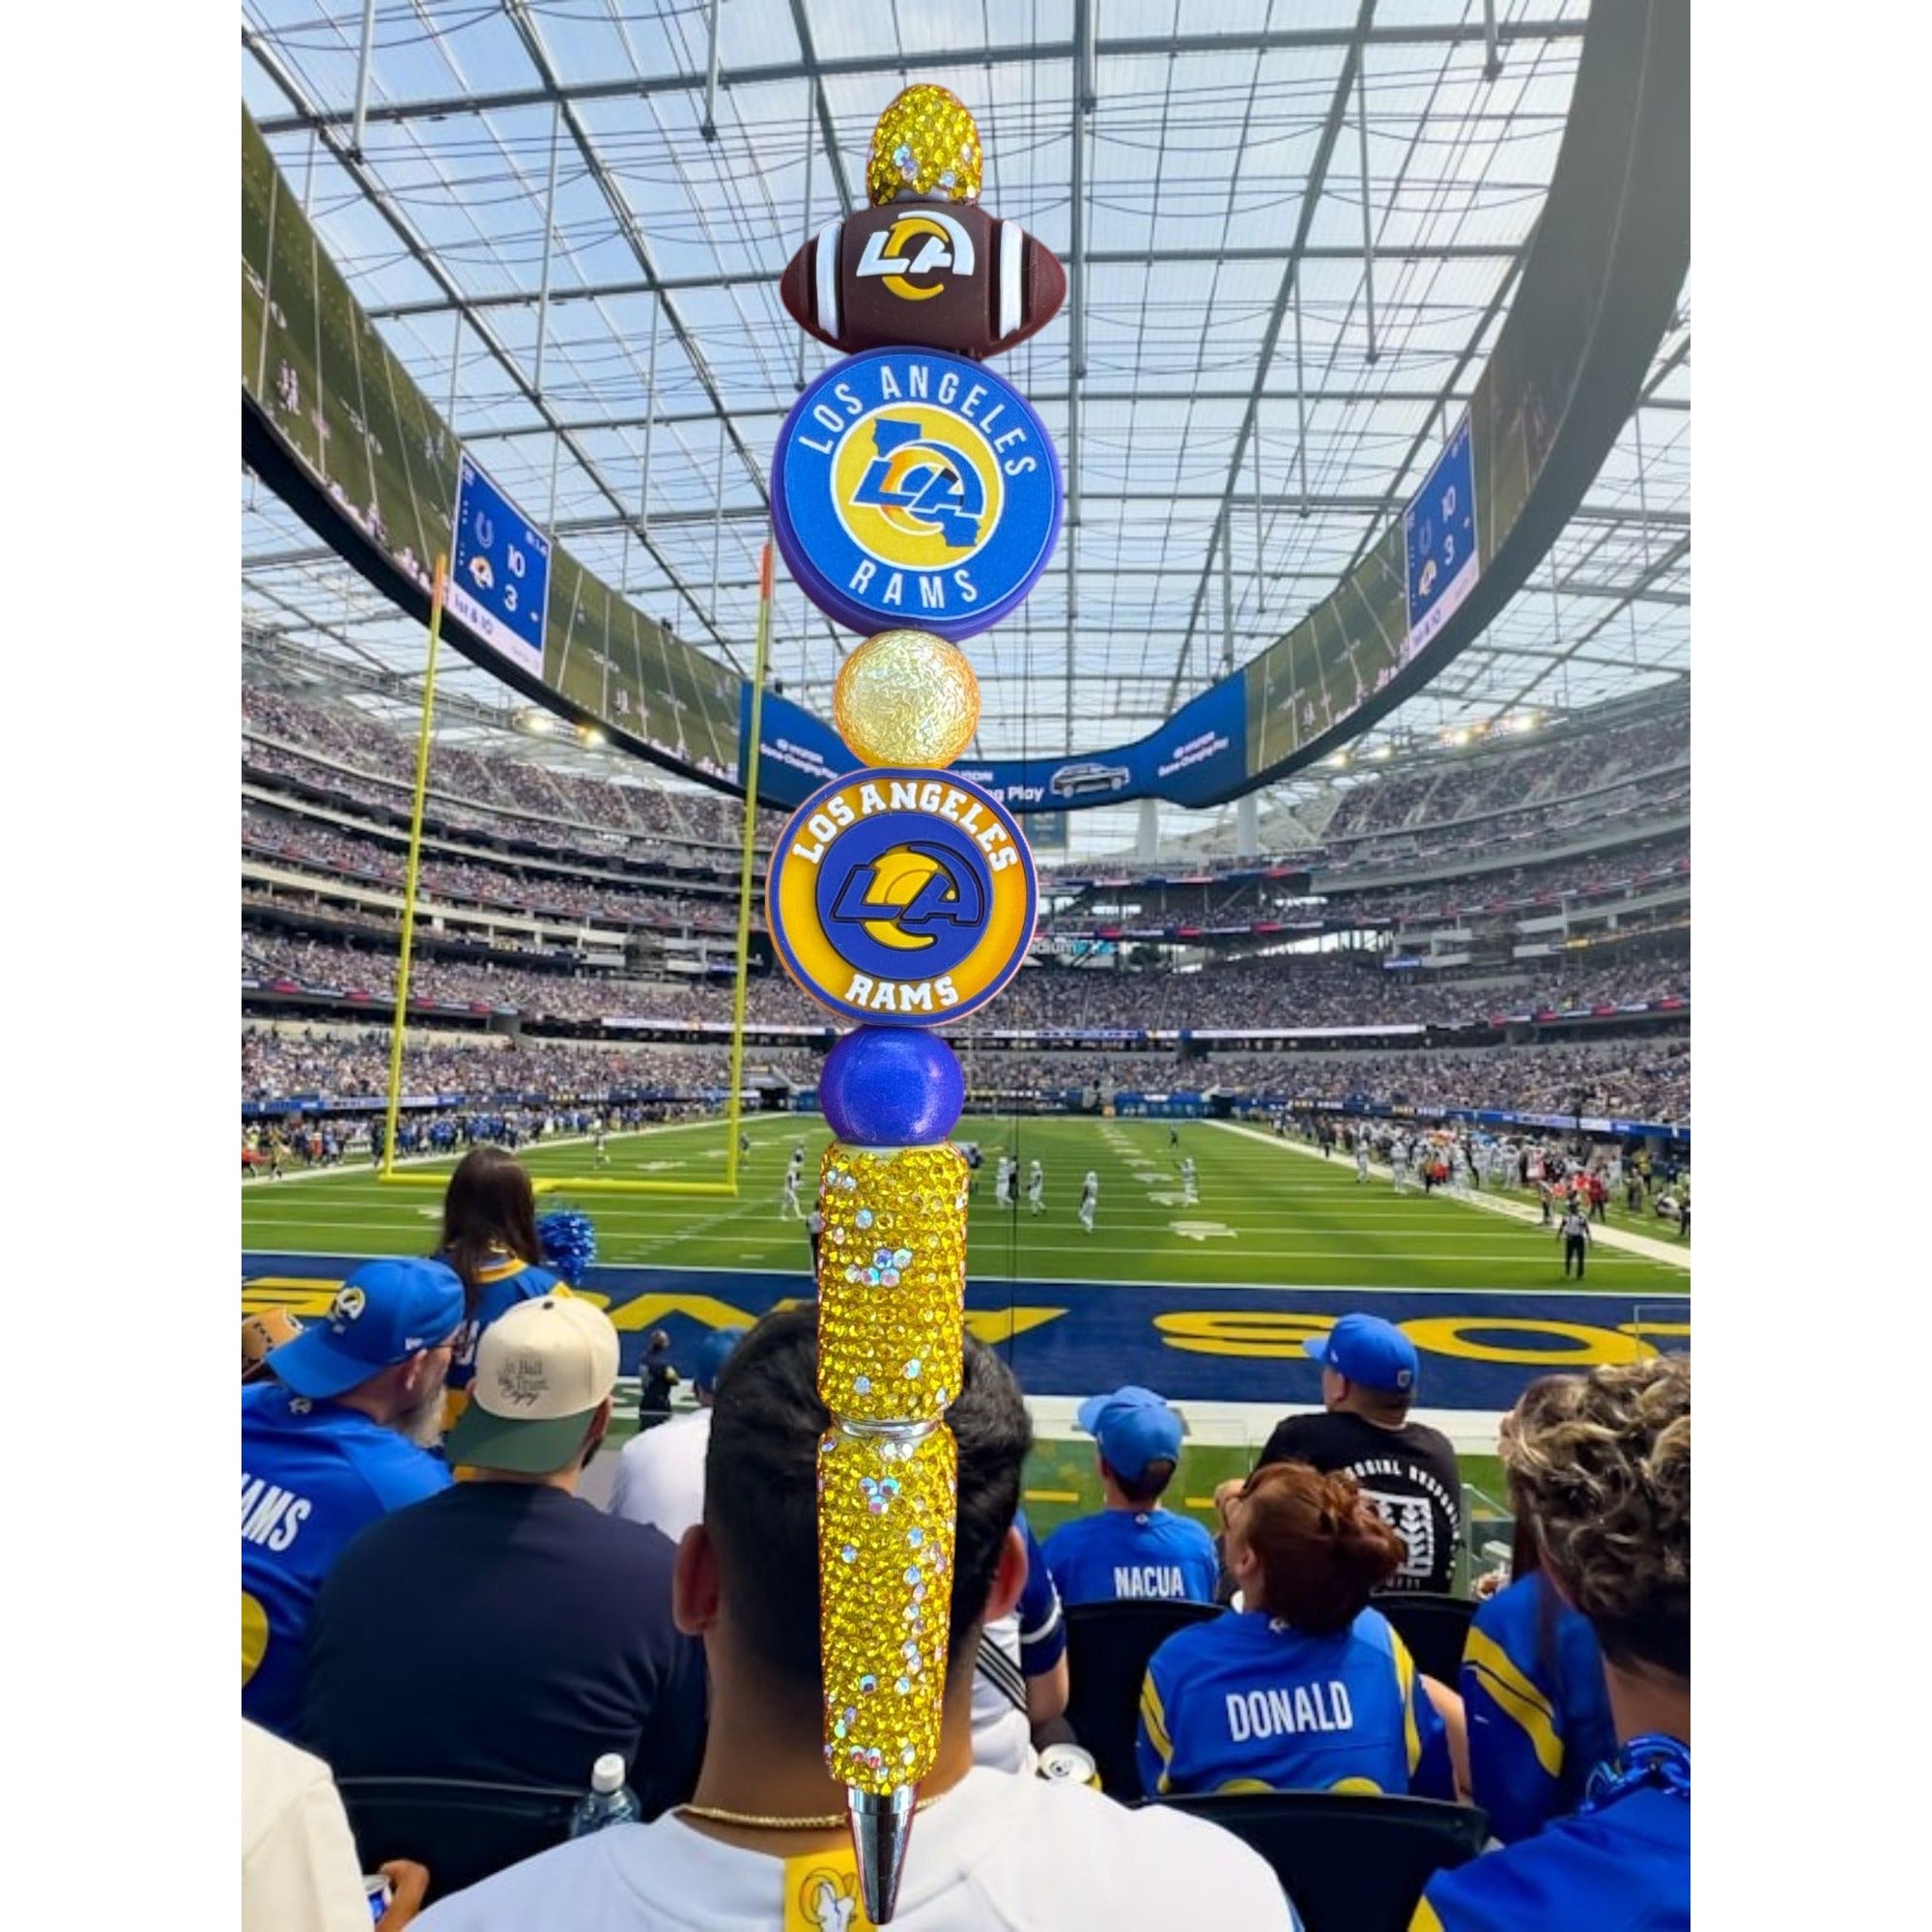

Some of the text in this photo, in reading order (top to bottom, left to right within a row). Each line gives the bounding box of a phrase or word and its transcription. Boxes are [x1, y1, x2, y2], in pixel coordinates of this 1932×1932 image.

[798, 364, 1037, 478] LOS ANGELES
[1441, 486, 1456, 524] 10
[507, 543, 526, 579] 10
[1444, 533, 1456, 566] 3
[504, 582, 519, 612] 3
[848, 559, 978, 610] RAMS
[1008, 784, 1044, 803] Play
[792, 781, 1019, 872] LOS ANGELES
[844, 973, 959, 1011] RAMS
[242, 1472, 313, 1551] AMS
[1113, 1565, 1185, 1599] NACUA
[1225, 1680, 1353, 1742] DONALD
